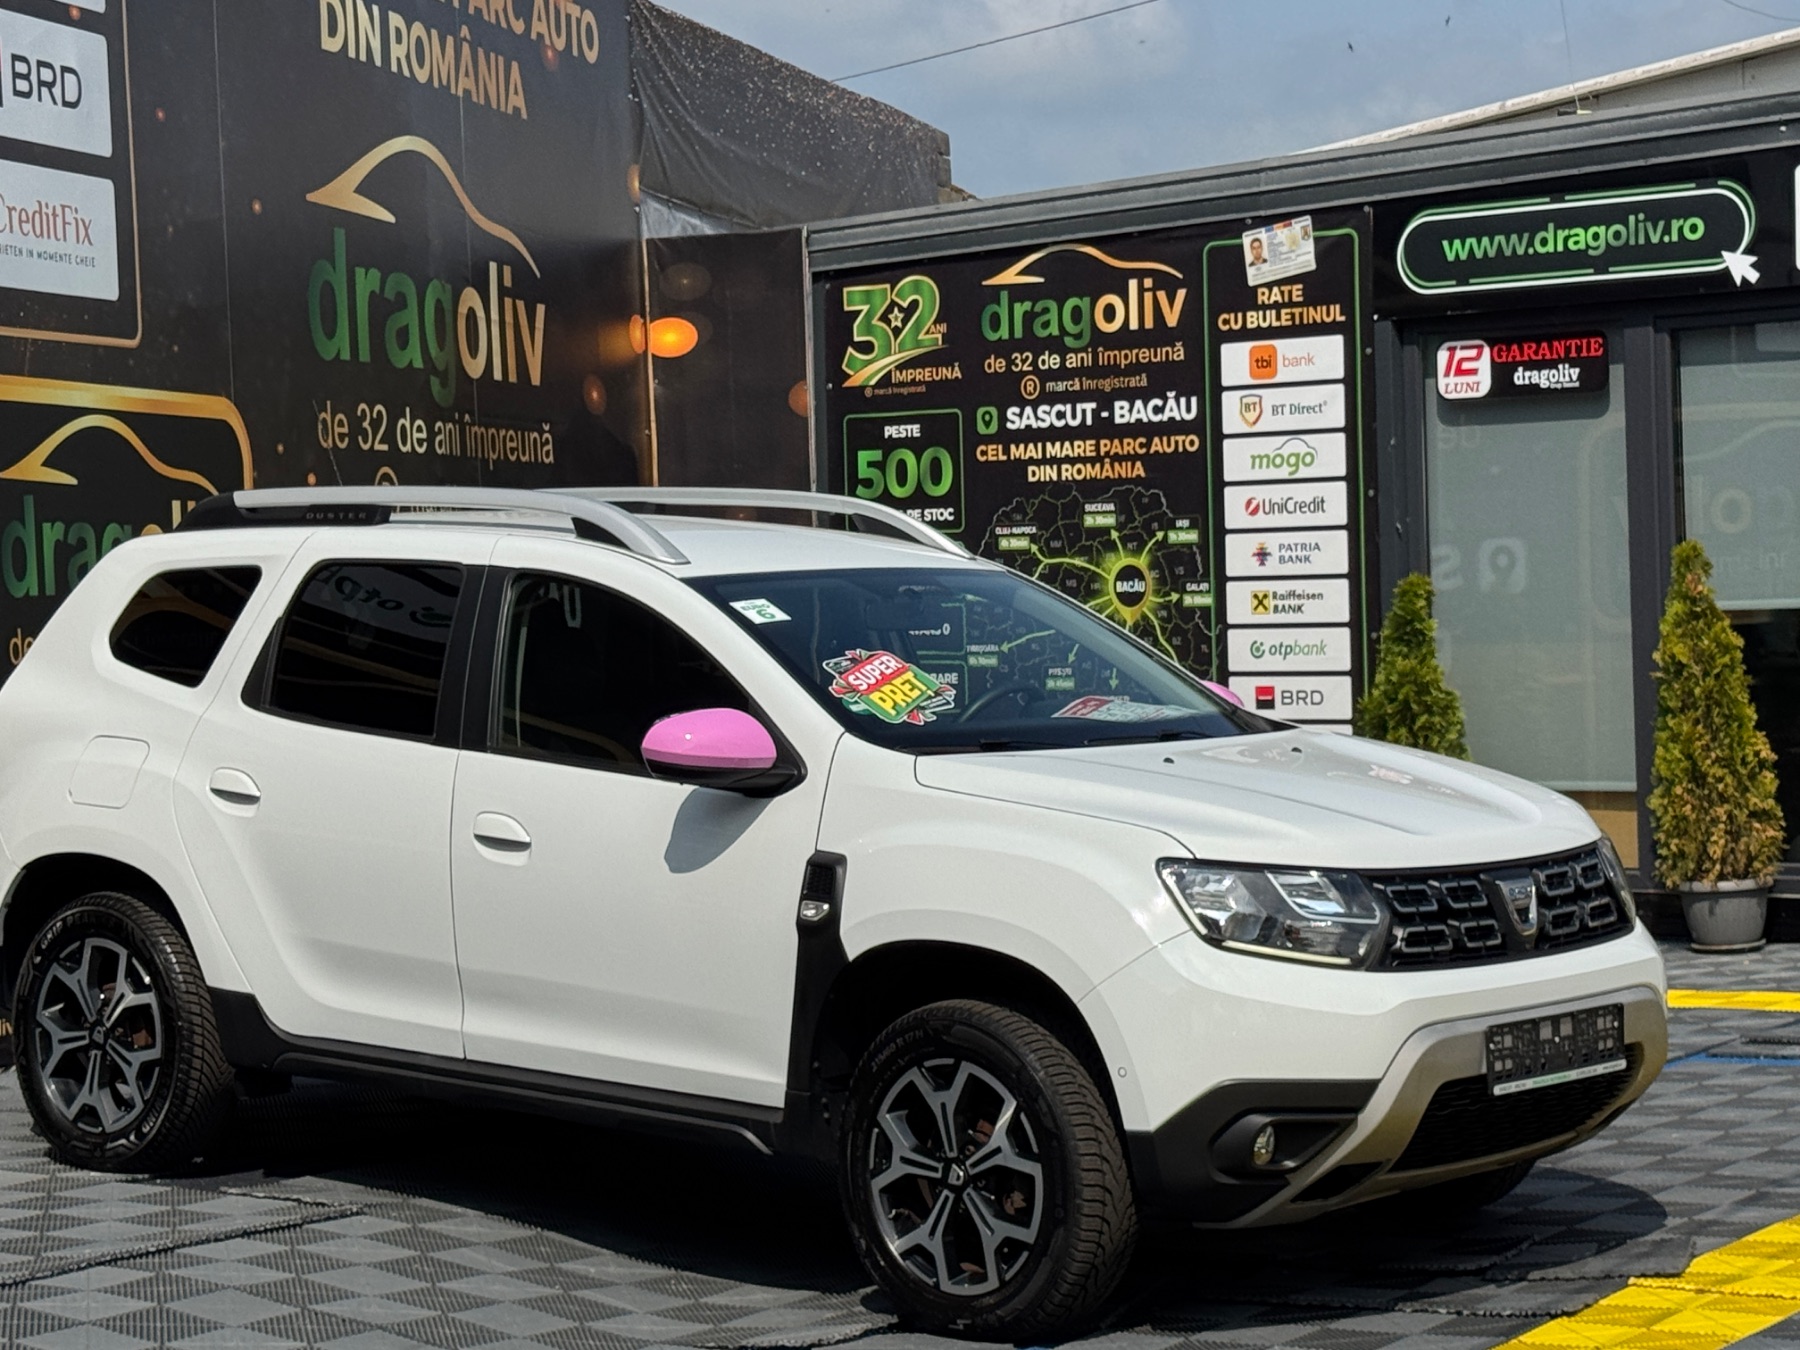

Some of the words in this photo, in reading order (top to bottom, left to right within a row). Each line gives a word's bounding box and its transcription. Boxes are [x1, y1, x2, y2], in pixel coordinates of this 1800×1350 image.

[530, 0, 599, 64] AUTO
[320, 0, 381, 68] DIN
[388, 10, 528, 120] ROMÂNIA
[11, 53, 82, 110] BRD
[0, 193, 94, 246] reditFix
[1441, 212, 1706, 262] www.dragoliv.ro
[1257, 284, 1304, 305] RATE
[307, 227, 546, 409] dragoliv
[841, 274, 943, 377] 32
[929, 322, 947, 335] ANI
[981, 278, 1187, 349] dragoliv
[1217, 312, 1242, 331] CU
[1246, 304, 1346, 329] BULETINUL
[984, 354, 1006, 373] de
[1011, 352, 1033, 372] 32
[1038, 350, 1061, 370] de
[1065, 347, 1092, 368] ani
[1097, 341, 1185, 369] împreună
[1254, 354, 1272, 369] tbi
[1282, 352, 1315, 368] bank
[1443, 344, 1485, 378] 12
[1492, 336, 1604, 363] GARANTIE
[1045, 377, 1080, 393] marcă
[1082, 373, 1147, 392] înregistrată
[1444, 381, 1481, 395] LUNI
[1513, 363, 1580, 389] dragoliv
[1005, 402, 1097, 430] SASCUT
[1113, 391, 1198, 424] BACĂU
[1244, 401, 1258, 413] BT
[1271, 403, 1287, 416] BT
[317, 400, 349, 450] de
[357, 402, 389, 452] 32
[397, 406, 428, 454] de
[434, 412, 461, 457] ani
[463, 413, 554, 471] împreună
[884, 424, 921, 439] PESTE
[976, 444, 1007, 462] CEL
[1010, 442, 1042, 460] MAI
[1046, 439, 1096, 458] MARE
[1100, 437, 1147, 456] PARC
[1150, 434, 1199, 454] AUTO
[855, 446, 953, 499] 500
[1027, 464, 1058, 482] DIN
[1061, 458, 1145, 481] ROMÂNIA
[1250, 451, 1315, 476] mogo
[924, 507, 955, 522] STOC
[1262, 496, 1326, 516] UniCredit
[1278, 542, 1321, 553] PATRIA
[1278, 555, 1312, 565] BANK
[1116, 578, 1146, 593] BACĂU
[1272, 589, 1324, 601] Raiffeisen
[756, 608, 776, 620] 6
[1272, 604, 1305, 614] BANK
[1268, 639, 1327, 661] otpbank
[848, 655, 903, 692] SUPER
[1281, 690, 1324, 705] BRD
